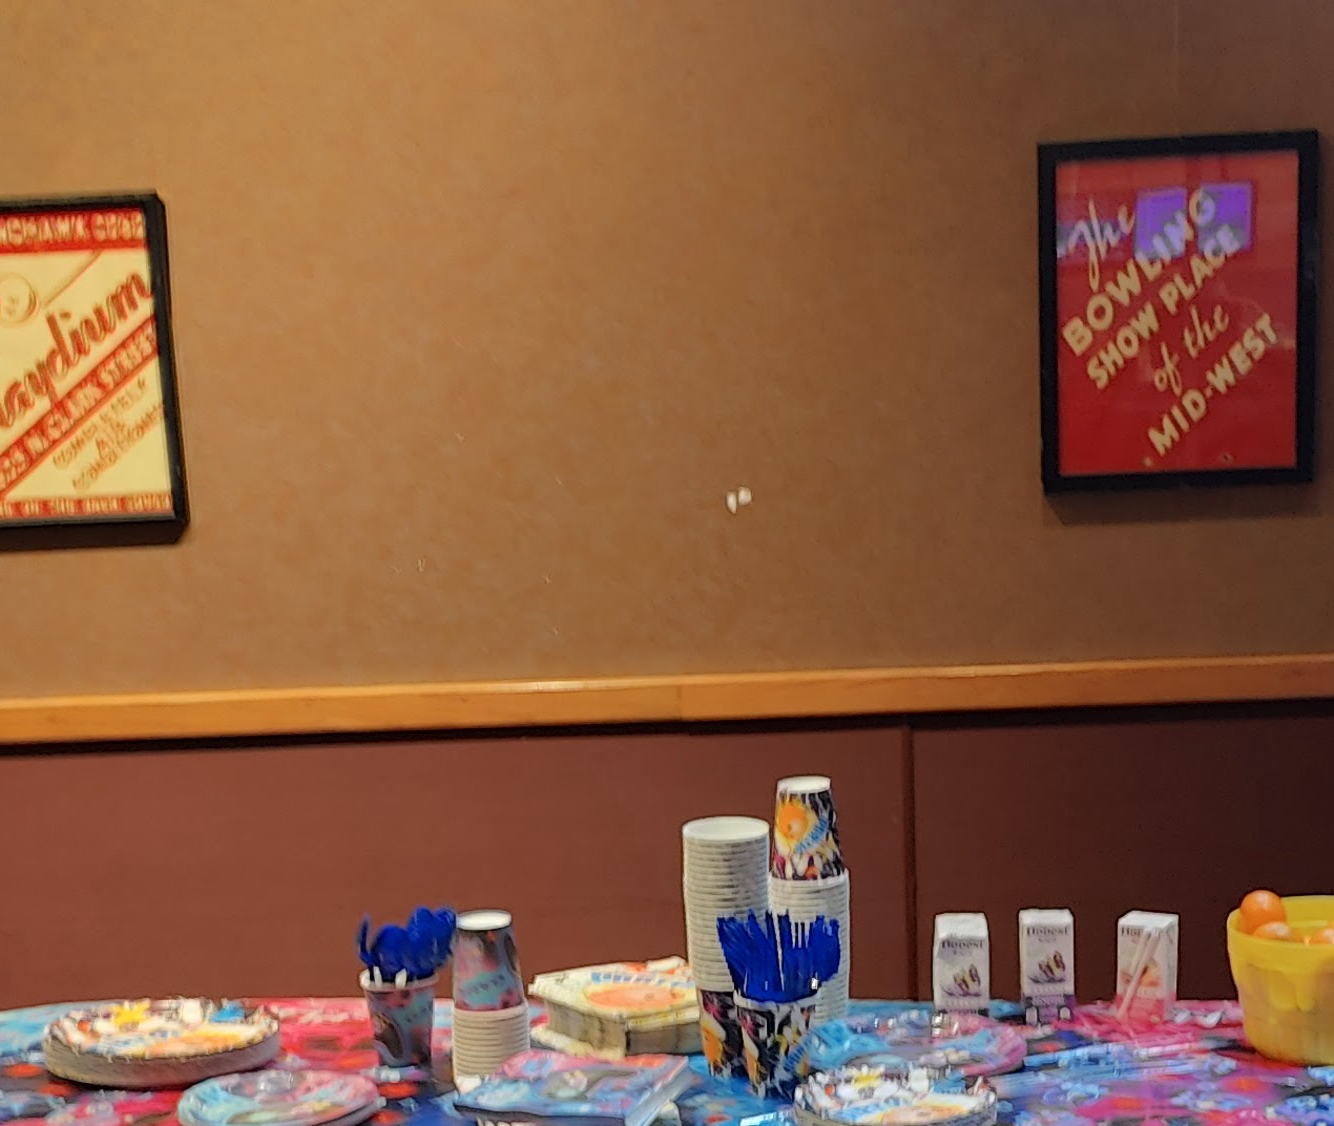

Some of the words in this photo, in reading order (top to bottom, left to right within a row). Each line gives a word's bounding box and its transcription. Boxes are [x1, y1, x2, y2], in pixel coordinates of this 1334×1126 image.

[1062, 188, 1217, 358] BOWLING
[1087, 302, 1159, 389] SHOW
[1158, 223, 1242, 316] PLACE
[1153, 342, 1184, 396] of
[1183, 304, 1229, 359] the
[1148, 311, 1278, 457] MID-WEST
